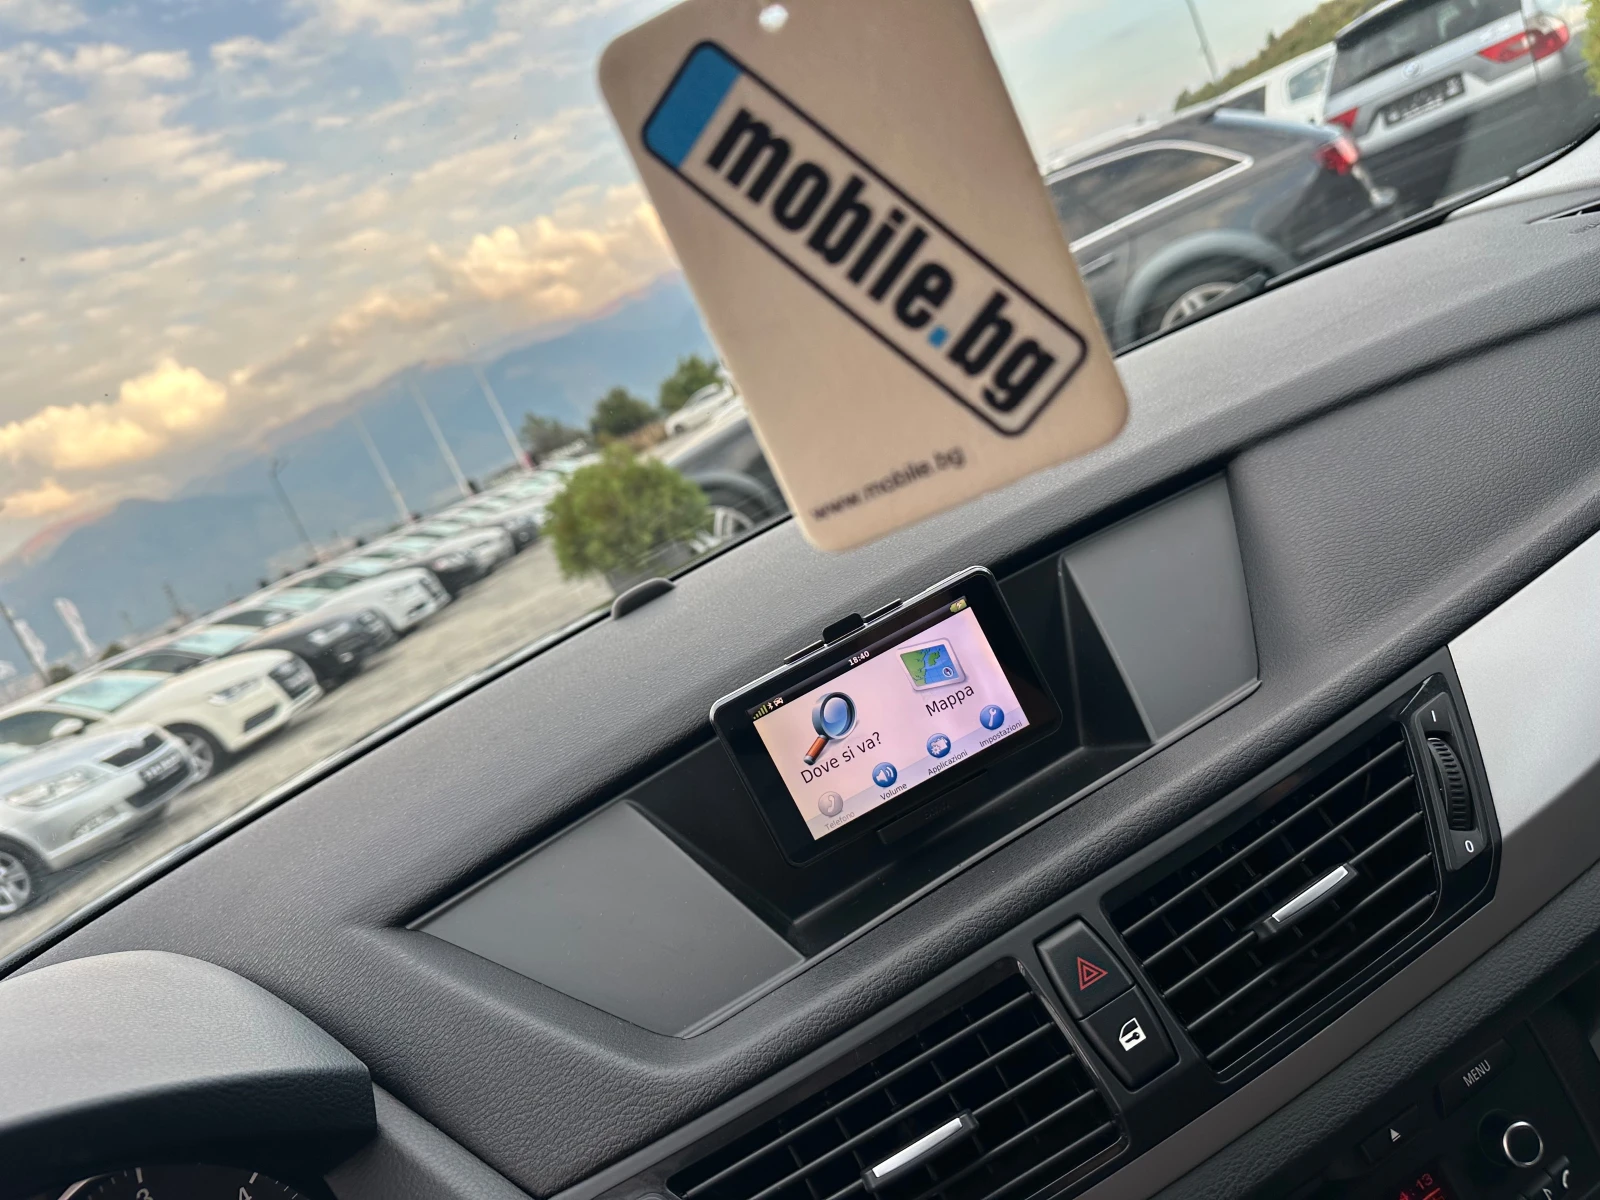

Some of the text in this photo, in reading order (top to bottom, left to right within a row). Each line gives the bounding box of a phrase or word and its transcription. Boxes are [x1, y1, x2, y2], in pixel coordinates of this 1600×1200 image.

[704, 108, 1059, 414] mobile.bg
[811, 446, 966, 522] www.mobile.bg
[848, 650, 870, 667] 18:40
[925, 683, 975, 717] Mappa
[979, 720, 1023, 748] Impostazioni
[800, 731, 882, 784] Dove si va?
[927, 749, 968, 776] Applicazioni
[880, 782, 908, 802] Volume
[824, 810, 856, 831] Telefono
[1462, 1059, 1492, 1088] MENU
